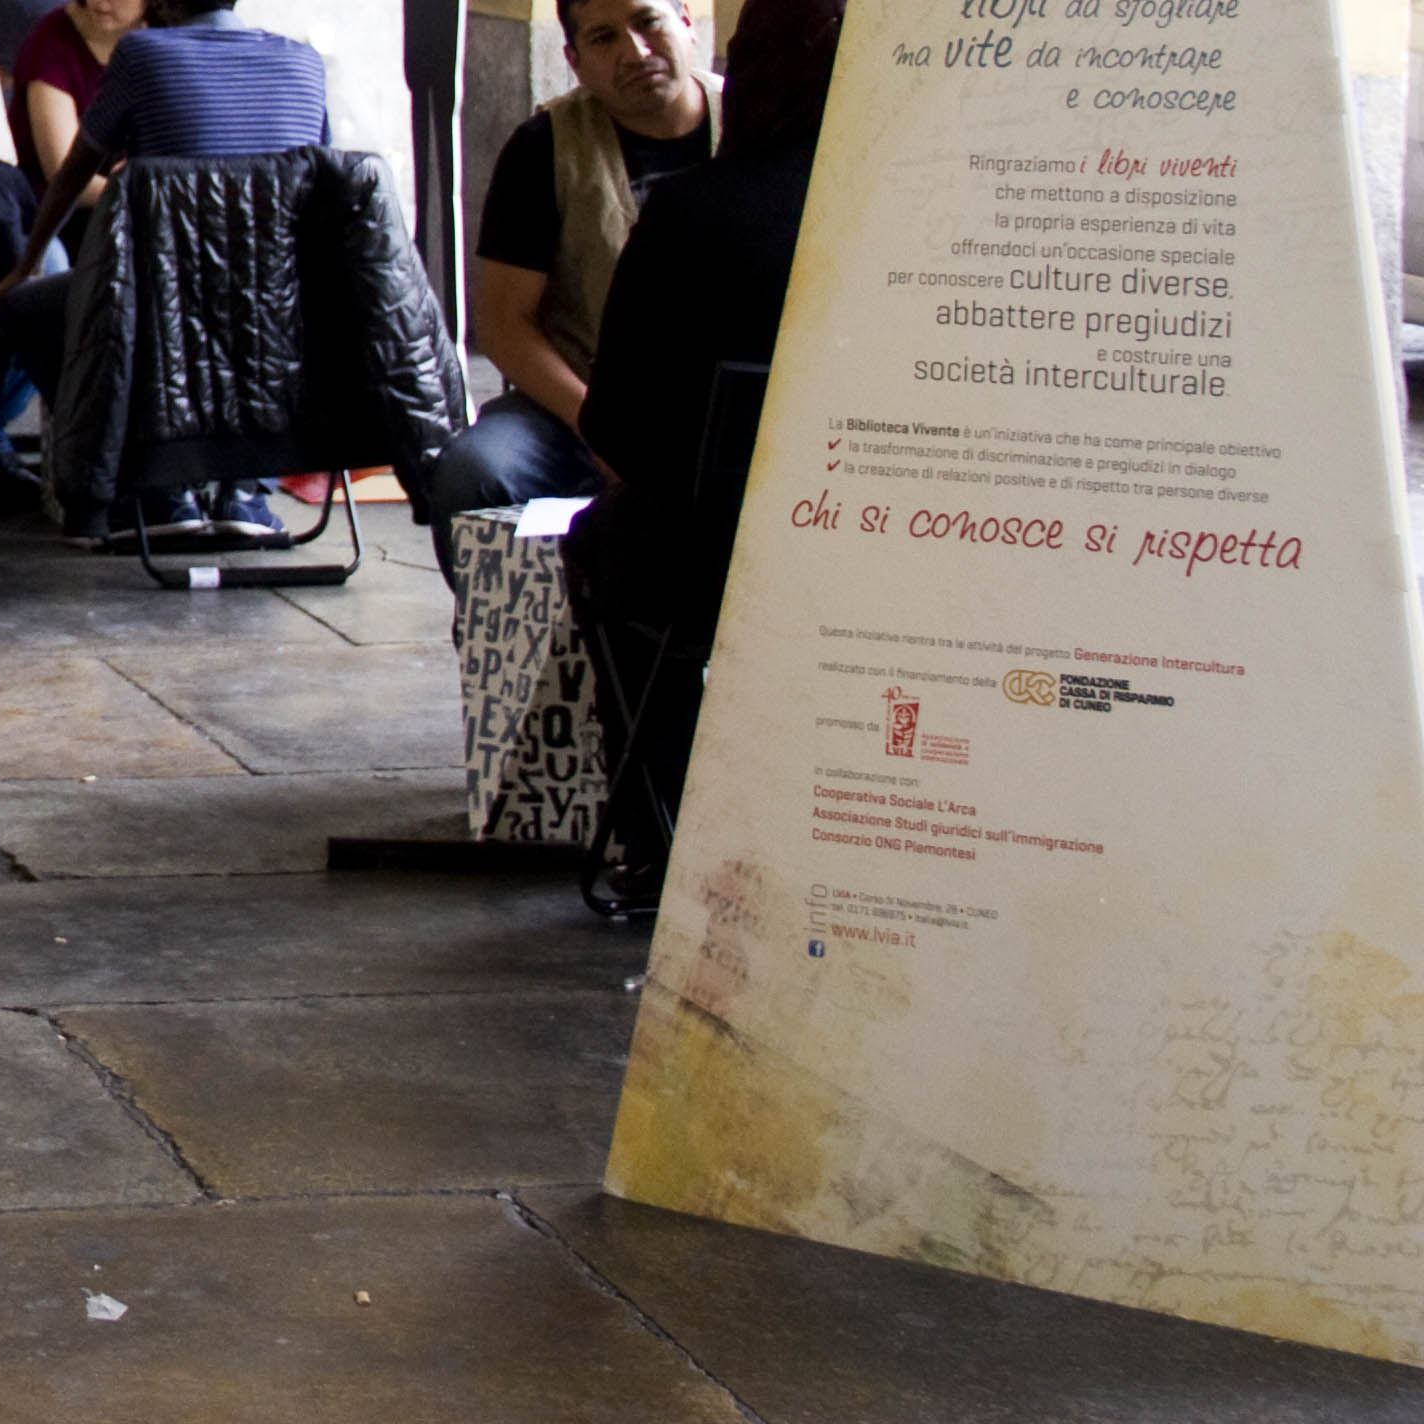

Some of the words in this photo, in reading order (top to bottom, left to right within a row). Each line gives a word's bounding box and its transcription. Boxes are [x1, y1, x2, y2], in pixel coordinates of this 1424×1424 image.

[892, 43, 929, 67] ma
[944, 29, 1013, 68] vite
[1026, 39, 1060, 68] da
[1075, 43, 1222, 75] incontrare
[1066, 87, 1078, 109] e
[1094, 85, 1236, 116] conoscere
[969, 154, 1076, 180] Ringraziamo
[1079, 155, 1089, 174] i
[1097, 149, 1148, 180] libri
[1159, 155, 1238, 178] viventi
[995, 185, 1025, 201] che
[1031, 187, 1104, 204] mettono
[1109, 190, 1120, 203] a
[1124, 187, 1237, 207] disposizione
[994, 212, 1009, 229] la
[1014, 215, 1076, 236] propria
[1080, 218, 1176, 237] esperienza
[1181, 219, 1198, 235] di
[1202, 220, 1236, 236] vita
[951, 240, 1036, 259] offrendoci
[1160, 247, 1235, 267] speciale
[887, 270, 913, 286] per
[918, 272, 1003, 289] conoscere
[1009, 264, 1111, 294] culture
[936, 299, 1075, 332] abbattere
[1085, 309, 1232, 342] pregiudizi
[913, 357, 1014, 386] società
[1097, 348, 1107, 362] e
[1112, 347, 1193, 367] costruire
[1198, 353, 1232, 368] una
[846, 418, 909, 435] Biblioteca
[912, 422, 959, 438] Vivente
[1056, 432, 1080, 446] che
[1083, 433, 1101, 447] ha
[1104, 436, 1143, 450] come
[1146, 439, 1215, 456] principale
[1218, 442, 1281, 459] obiettivo
[848, 439, 860, 453] la
[863, 441, 959, 460] trasformazione
[962, 447, 974, 460] di
[977, 448, 1081, 469] discriminazione
[1084, 457, 1094, 469] e
[1097, 459, 1164, 475] pregiudizi
[1168, 462, 1181, 475] in
[1184, 464, 1237, 481] dialogo
[844, 461, 855, 474] la
[858, 464, 918, 478] creazione
[921, 466, 934, 479] di
[936, 468, 991, 484] relazioni
[994, 471, 1046, 488] positive
[1060, 476, 1073, 489] di
[1076, 479, 1130, 494] rispetto
[1133, 482, 1153, 495] tra
[1156, 484, 1214, 500] persone
[1217, 488, 1269, 503] diverse
[792, 489, 842, 530] chi
[860, 505, 891, 534] si
[909, 510, 1064, 549] conosce
[1084, 524, 1118, 553] si
[1132, 529, 1303, 577] rispetta
[1024, 647, 1070, 661] progetto
[1074, 647, 1158, 668] Generazione
[1161, 655, 1245, 676] Intercultura
[1059, 673, 1129, 691] FONDAZIONE
[1059, 685, 1096, 700] CASSA
[1099, 689, 1110, 701] DI
[1113, 691, 1174, 708] RISPARMIO
[1059, 697, 1070, 709] DI
[1073, 699, 1112, 713] CUNEO
[812, 784, 887, 806] Cooperativa
[889, 793, 935, 811] Sociale
[937, 799, 977, 817] L'Arca
[812, 807, 892, 828] Associazione
[895, 815, 928, 833] Studi
[930, 823, 982, 841] giuridici
[812, 828, 873, 848] Consorzio
[875, 837, 902, 852] ONG
[904, 840, 976, 861] Piemontesi
[831, 924, 917, 948] www.lvia.it
